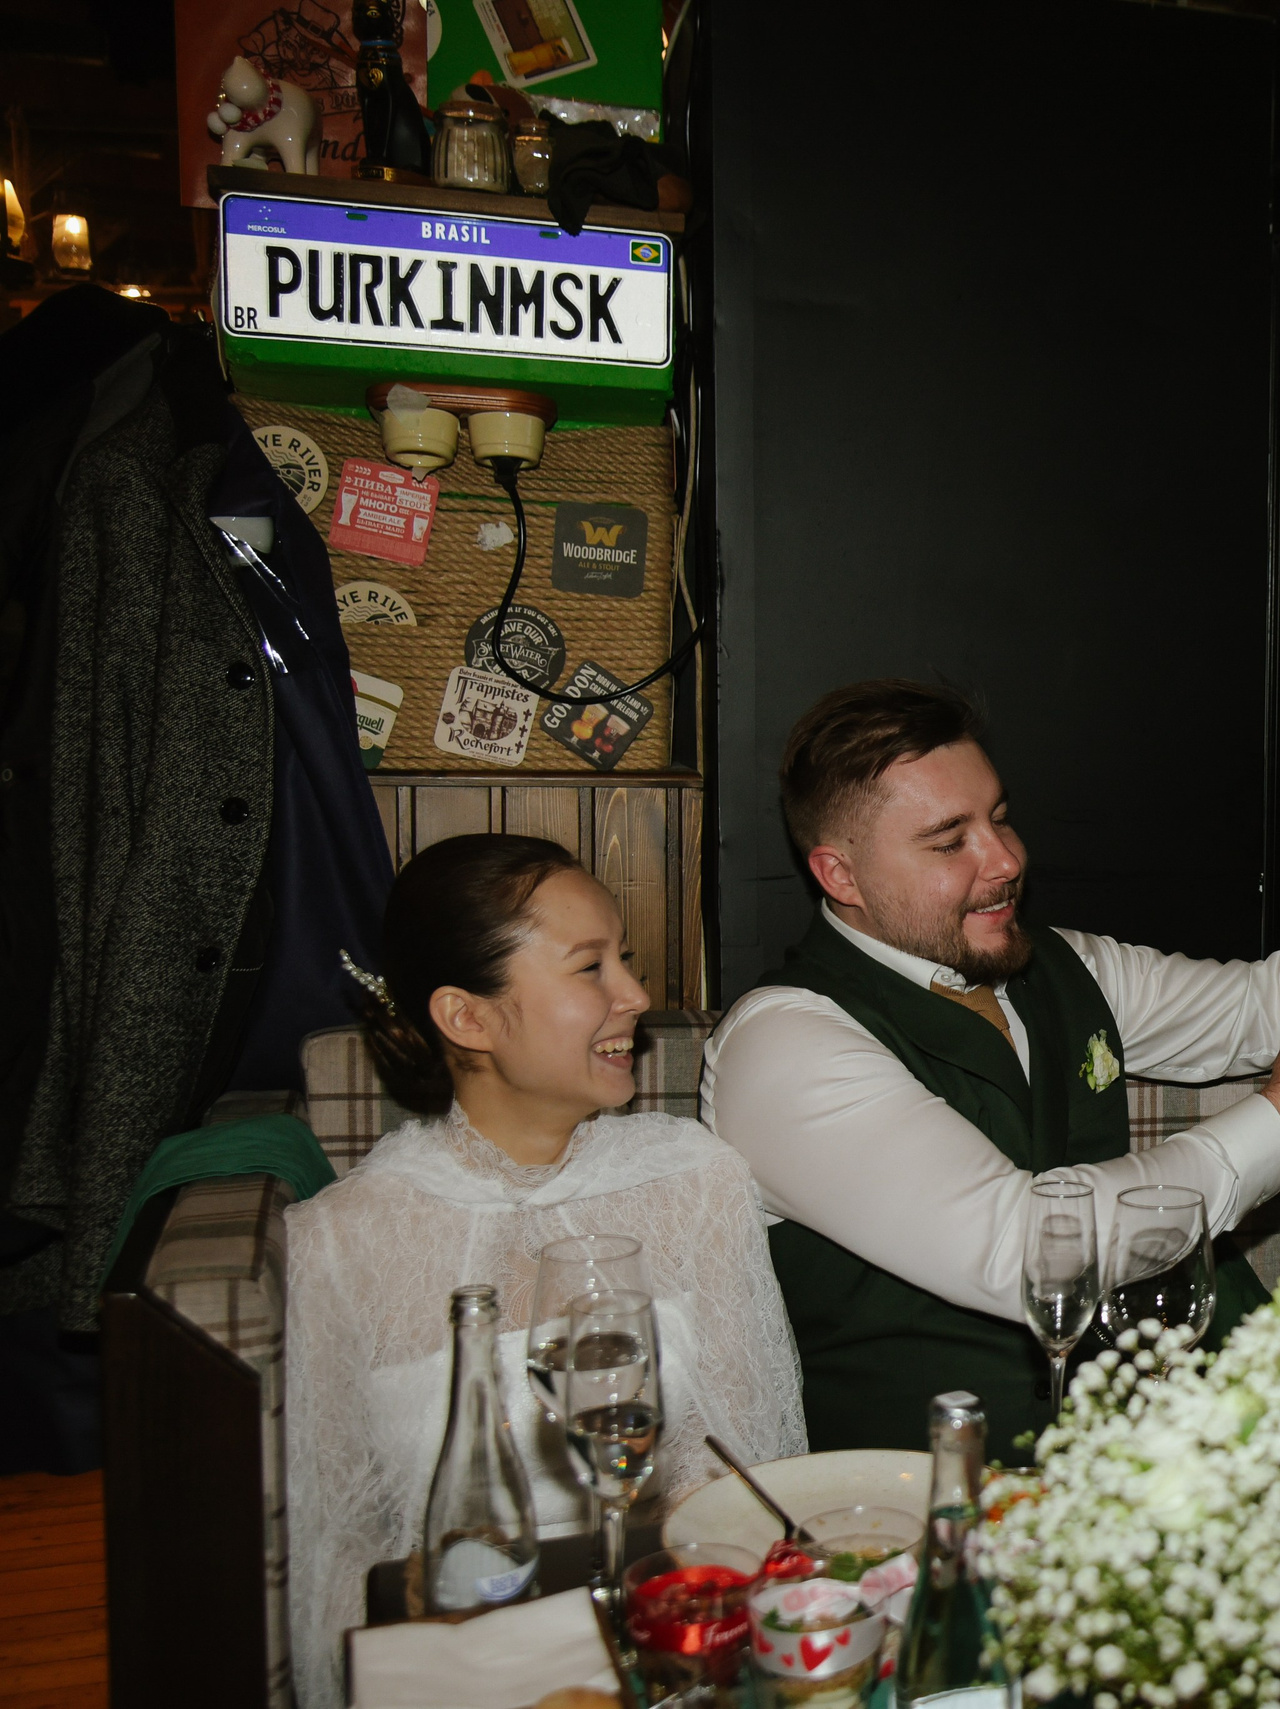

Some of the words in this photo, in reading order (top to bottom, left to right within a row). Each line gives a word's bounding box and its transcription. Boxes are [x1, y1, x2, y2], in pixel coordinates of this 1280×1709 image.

[247, 224, 287, 235] MERCOSUL
[421, 221, 491, 245] BRASIL
[265, 244, 623, 344] PURKINMSK
[233, 305, 259, 330] BR
[257, 434, 282, 448] YE
[288, 438, 322, 493] RIVER
[353, 477, 393, 495] ПИВА
[400, 490, 430, 502] IMPERIAL
[359, 497, 398, 513] МНОГО
[398, 498, 427, 510] STOUT
[363, 511, 388, 522] AMBER
[388, 517, 401, 525] ALE
[563, 542, 637, 565] WOODBRIDGE
[578, 562, 590, 570] ALE
[598, 564, 620, 572] STOUT
[368, 590, 409, 623] RIVE
[524, 625, 543, 645] OUR
[454, 675, 530, 704] Trappistes
[589, 682, 609, 696] CRAFT
[595, 673, 611, 689] BORN
[616, 687, 642, 710] TLAND
[356, 713, 385, 732] rquell
[448, 727, 514, 756] Rochefort
